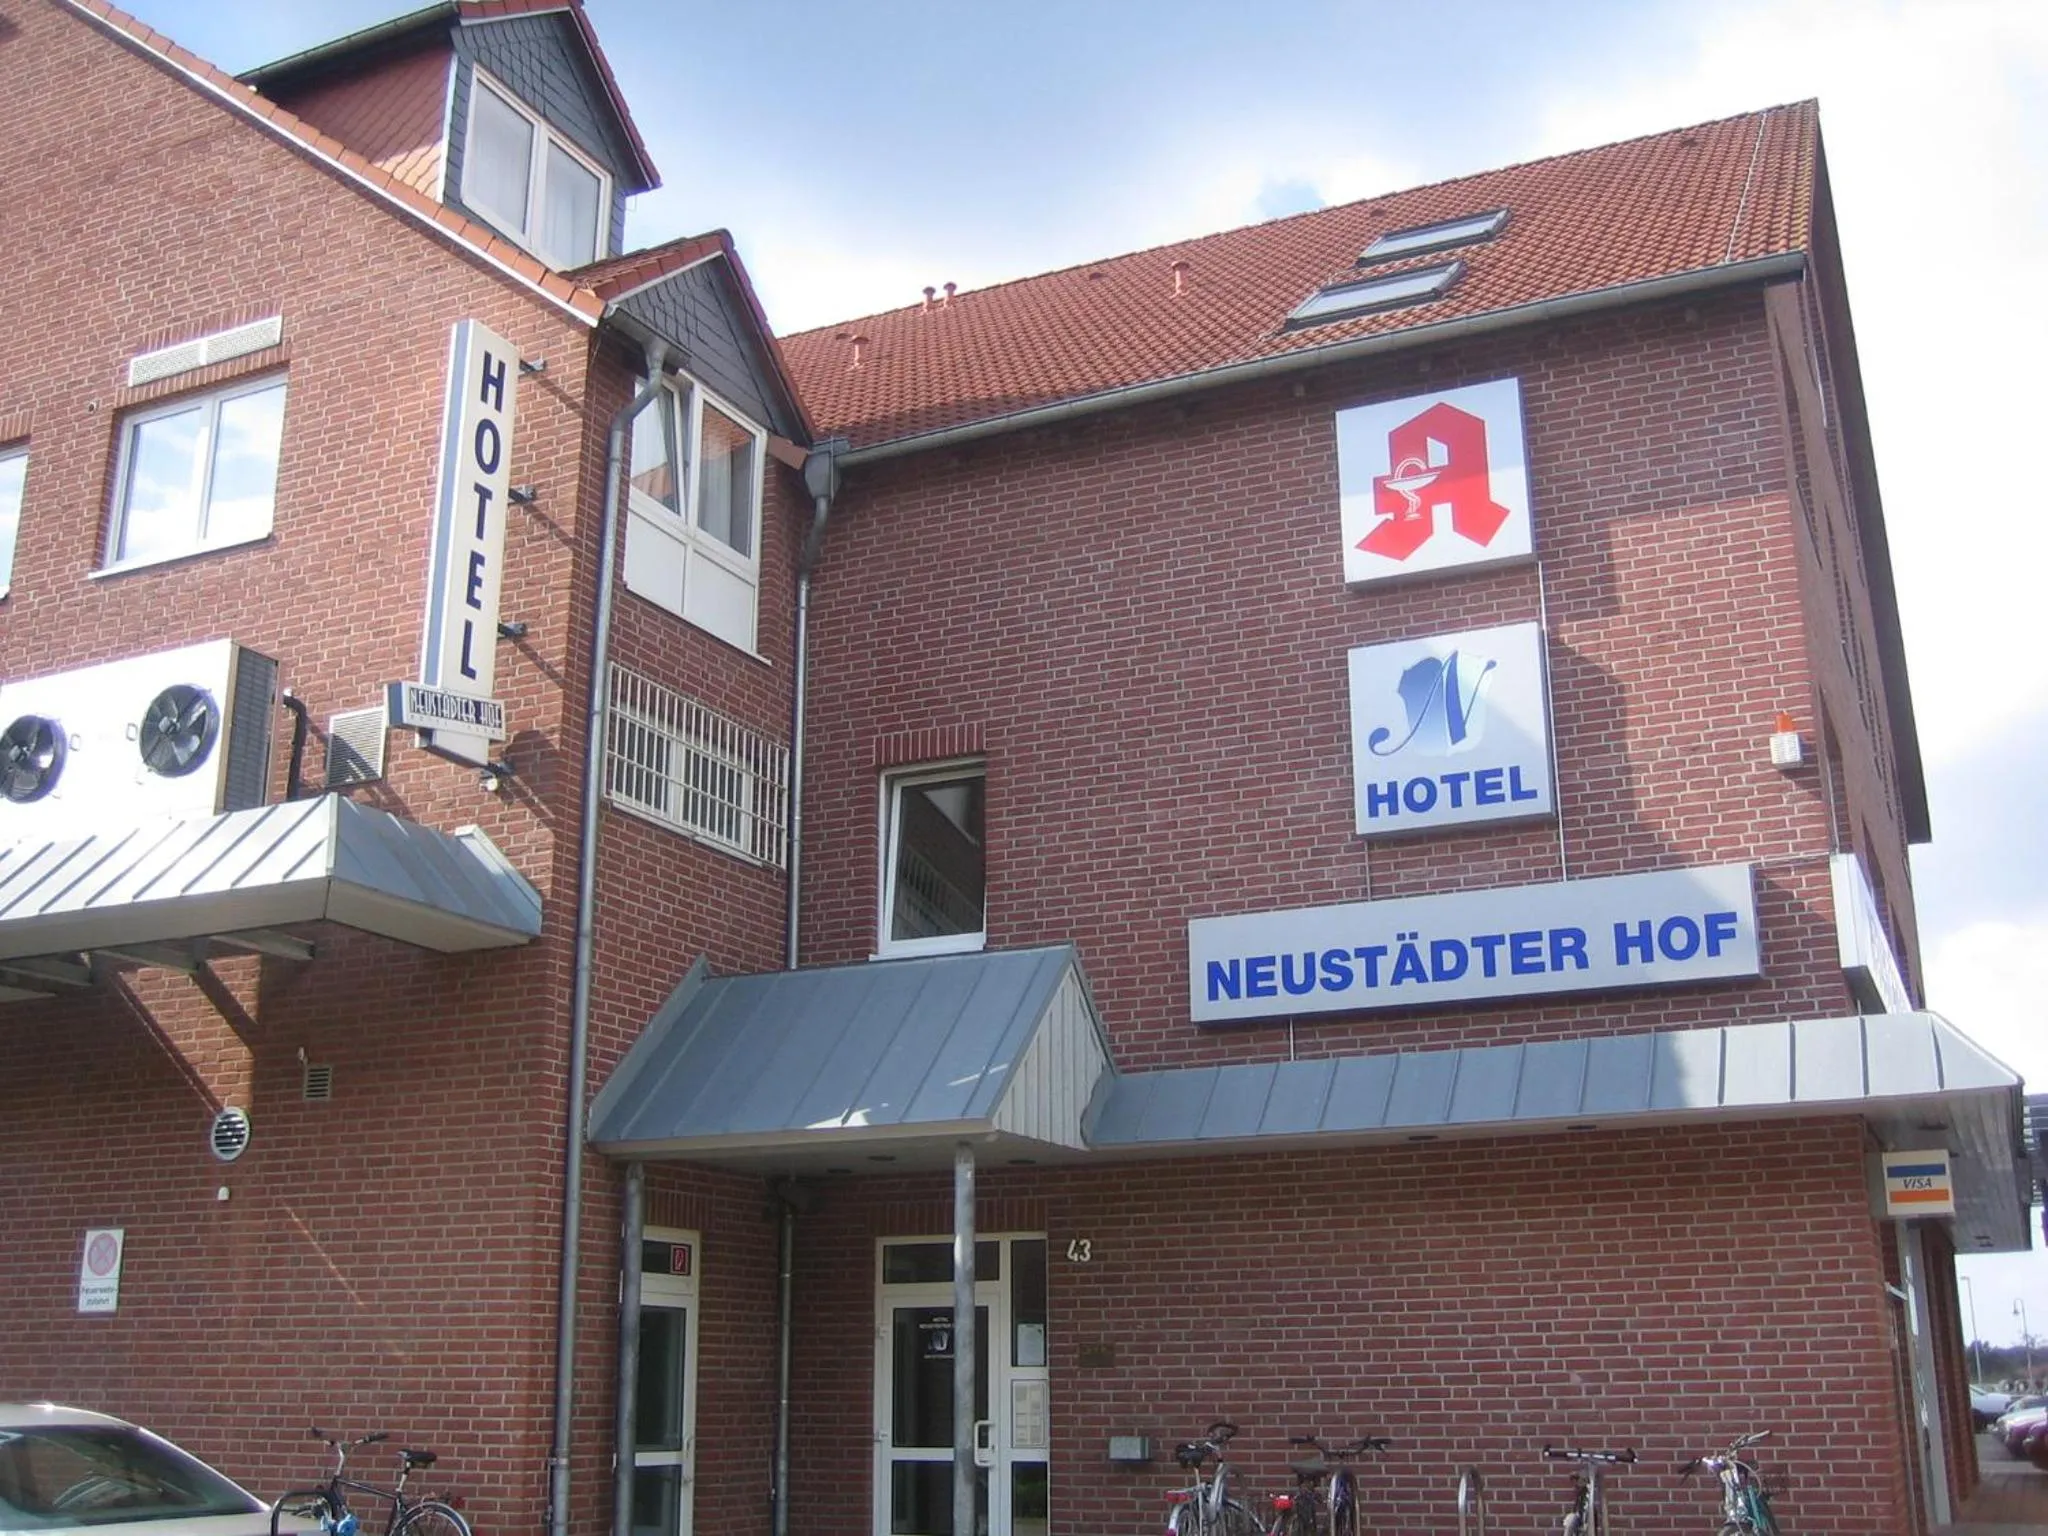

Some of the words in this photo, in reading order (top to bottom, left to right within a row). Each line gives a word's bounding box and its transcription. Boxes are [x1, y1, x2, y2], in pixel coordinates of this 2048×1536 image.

[460, 349, 506, 681] HOTEL
[1367, 765, 1538, 818] HOTEL
[1206, 926, 1589, 1002] NEUSTÄDTER
[1613, 911, 1738, 966] HOF
[1903, 1177, 1932, 1189] VISA
[1066, 1239, 1092, 1262] 43
